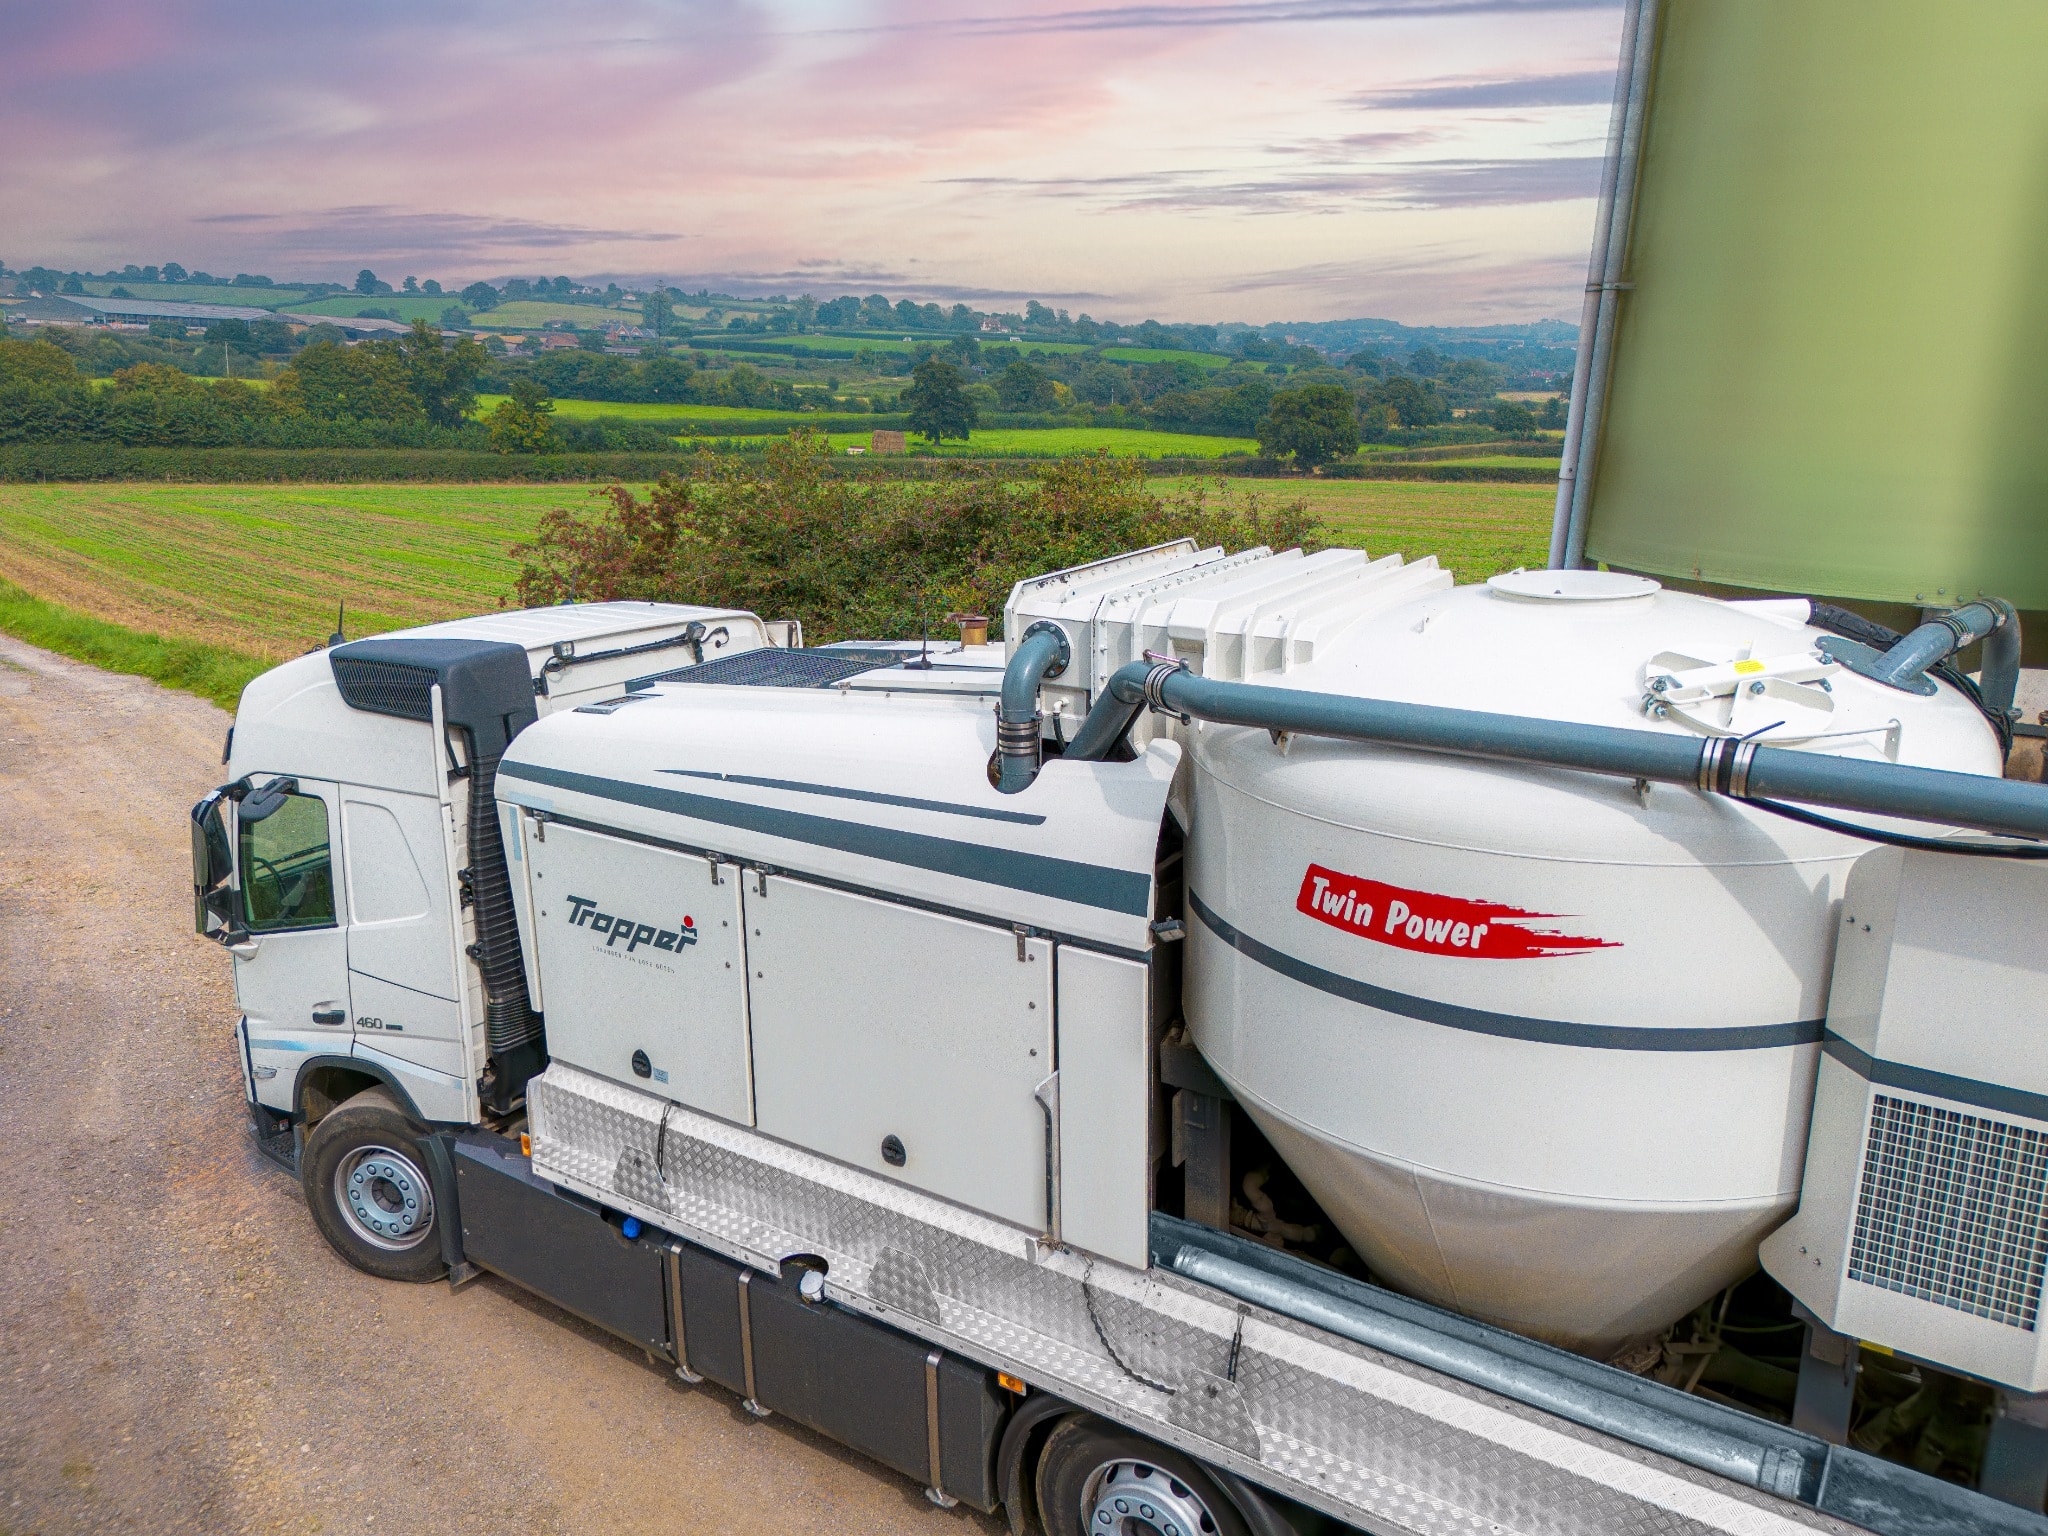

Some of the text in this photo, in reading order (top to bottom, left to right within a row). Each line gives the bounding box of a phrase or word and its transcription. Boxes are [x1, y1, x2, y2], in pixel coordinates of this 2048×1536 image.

[566, 894, 698, 954] Tropper
[1311, 876, 1488, 949] Twin Power
[356, 1016, 383, 1030] 460
